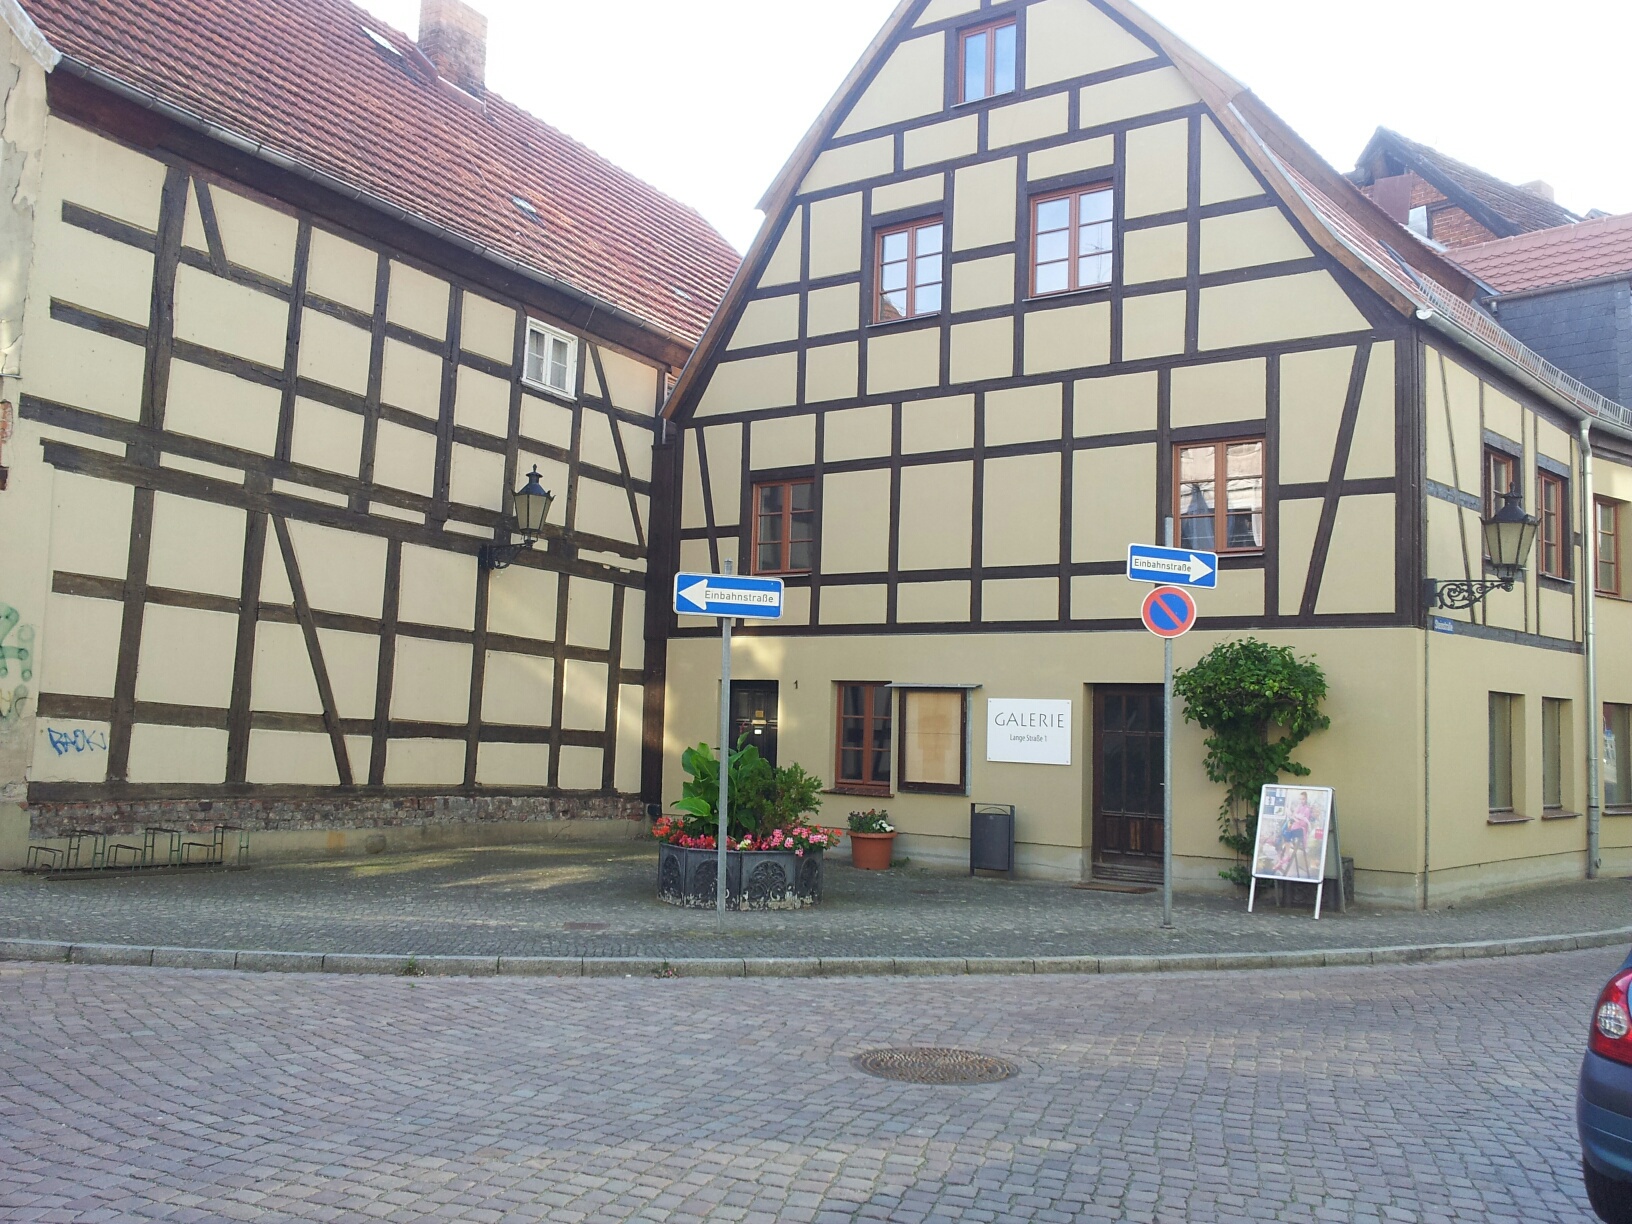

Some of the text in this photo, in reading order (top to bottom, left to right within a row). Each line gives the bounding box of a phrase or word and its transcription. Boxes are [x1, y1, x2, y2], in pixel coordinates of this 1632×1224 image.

[1134, 558, 1192, 573] Einbahnstraße
[704, 590, 774, 603] Einbahnstraße
[794, 680, 799, 690] 1
[994, 712, 1065, 729] GALERIE
[1009, 734, 1026, 743] Lange
[1026, 734, 1044, 743] Straße
